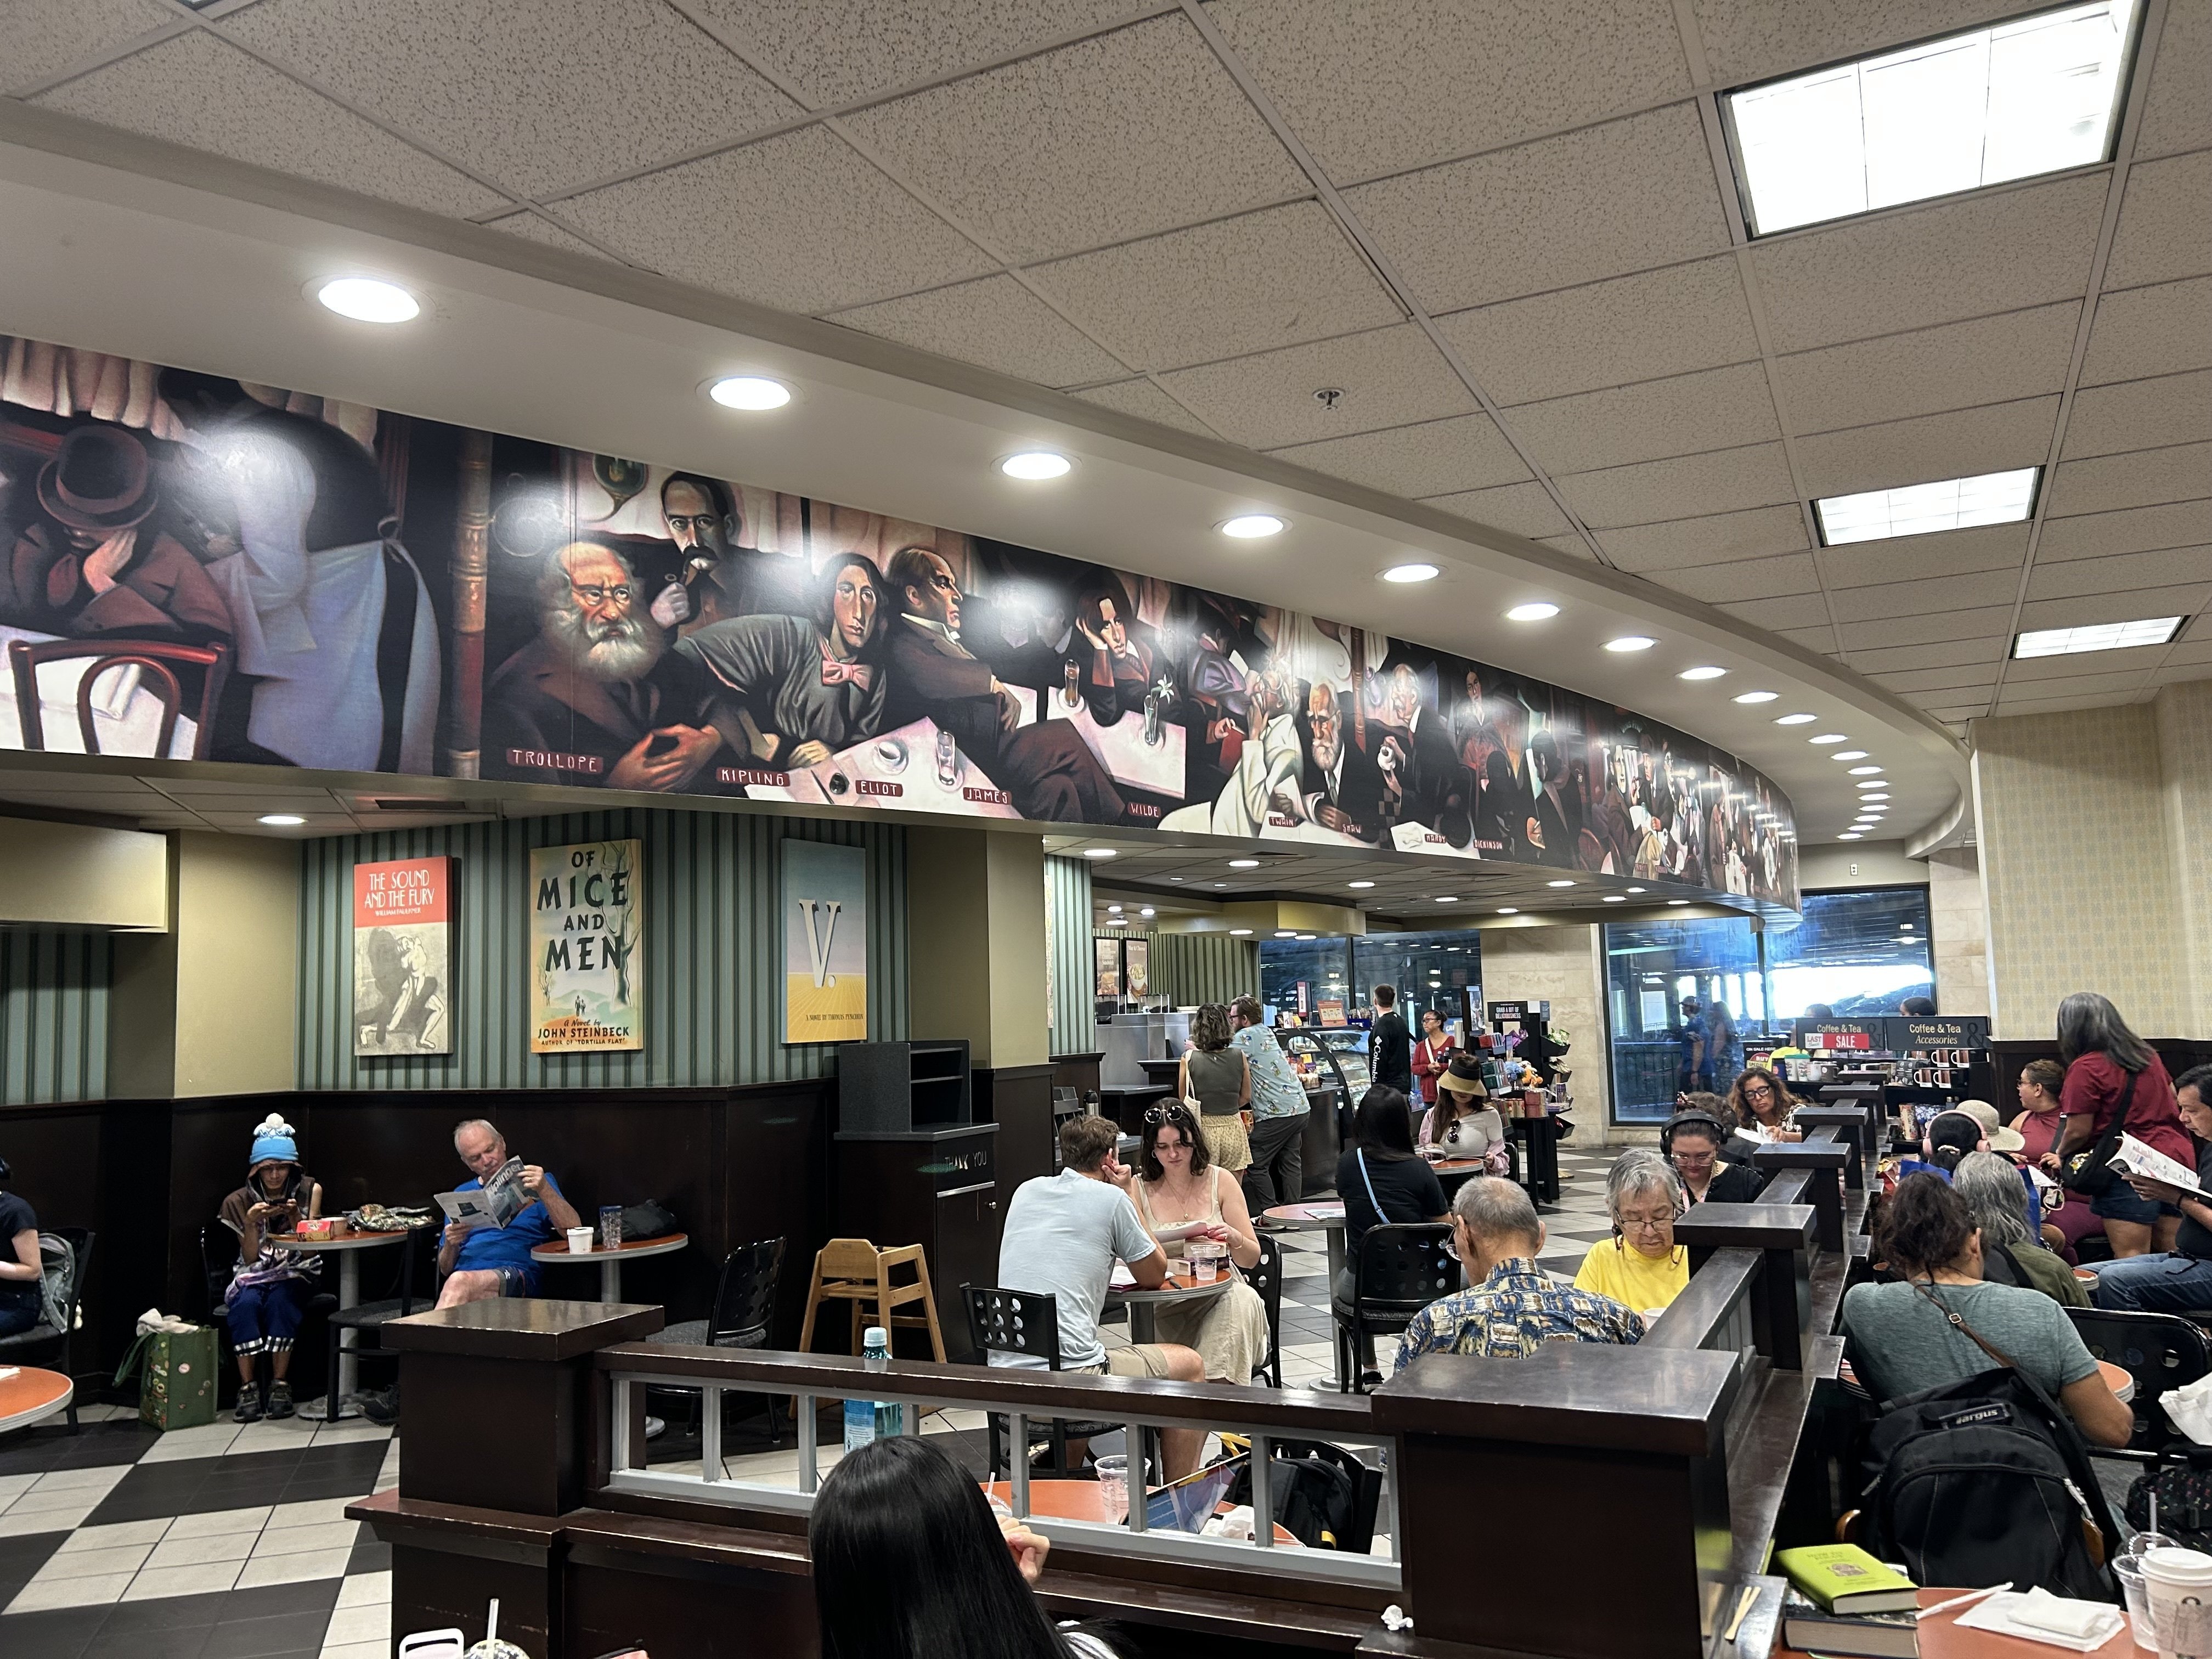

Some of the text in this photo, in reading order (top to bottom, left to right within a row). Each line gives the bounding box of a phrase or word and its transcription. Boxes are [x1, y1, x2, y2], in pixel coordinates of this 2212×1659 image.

[512, 749, 597, 772] TROLLOPE
[721, 769, 784, 786] KIPLING
[861, 781, 897, 795] ELIOT
[967, 788, 1008, 804] JAMES
[1131, 803, 1159, 817] WILDE
[1271, 817, 1294, 827] TWAIN
[1342, 824, 1361, 833] SHAW
[1426, 834, 1446, 843] HARDY
[1474, 839, 1503, 850] DICKINSON
[571, 851, 595, 868] OF
[369, 869, 430, 891] THE SOUND
[537, 870, 629, 911] MICE
[364, 888, 435, 909] AND THE FURY
[397, 907, 421, 916] FAULKNER
[563, 914, 604, 932] AND
[545, 935, 622, 972] MEN
[571, 1019, 591, 1027] Novel
[594, 1019, 601, 1028] by
[1817, 1024, 1861, 1033] Coffee & Tea
[1909, 1024, 1961, 1033] Coffee & Tea
[538, 1026, 630, 1039] JOHN STEINBECK
[1836, 1035, 1855, 1048] SALE
[1915, 1035, 1957, 1045] Accessories
[1372, 1045, 1381, 1082] Columbia
[945, 1150, 987, 1170] THANK YOU
